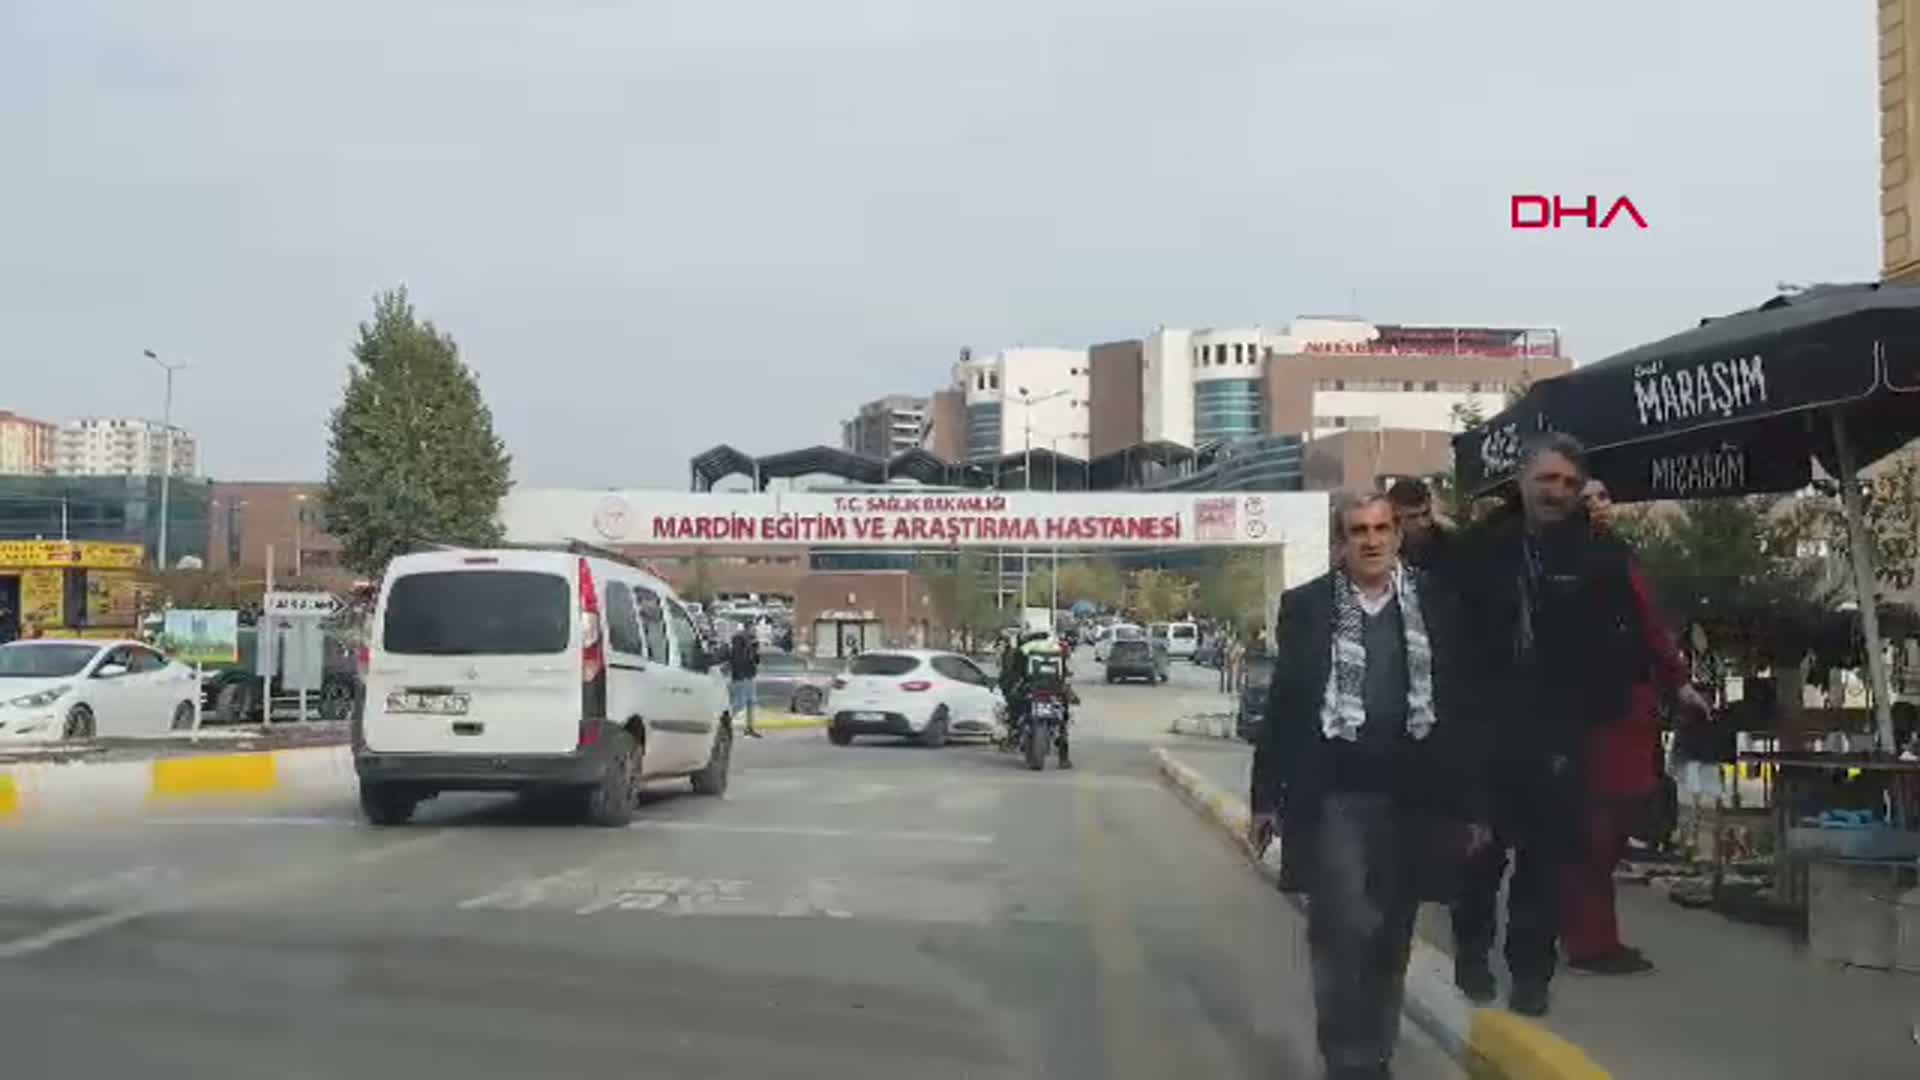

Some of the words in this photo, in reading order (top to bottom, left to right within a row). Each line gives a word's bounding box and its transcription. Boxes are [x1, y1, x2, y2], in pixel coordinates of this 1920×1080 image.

[1634, 355, 1767, 425] MARAŞIM
[652, 512, 755, 540] MARDİN
[761, 512, 846, 540] EĞİTİM
[853, 517, 886, 539] VE
[893, 516, 1039, 546] ARAŞTIRMA
[1046, 512, 1181, 540] HASTANESİ
